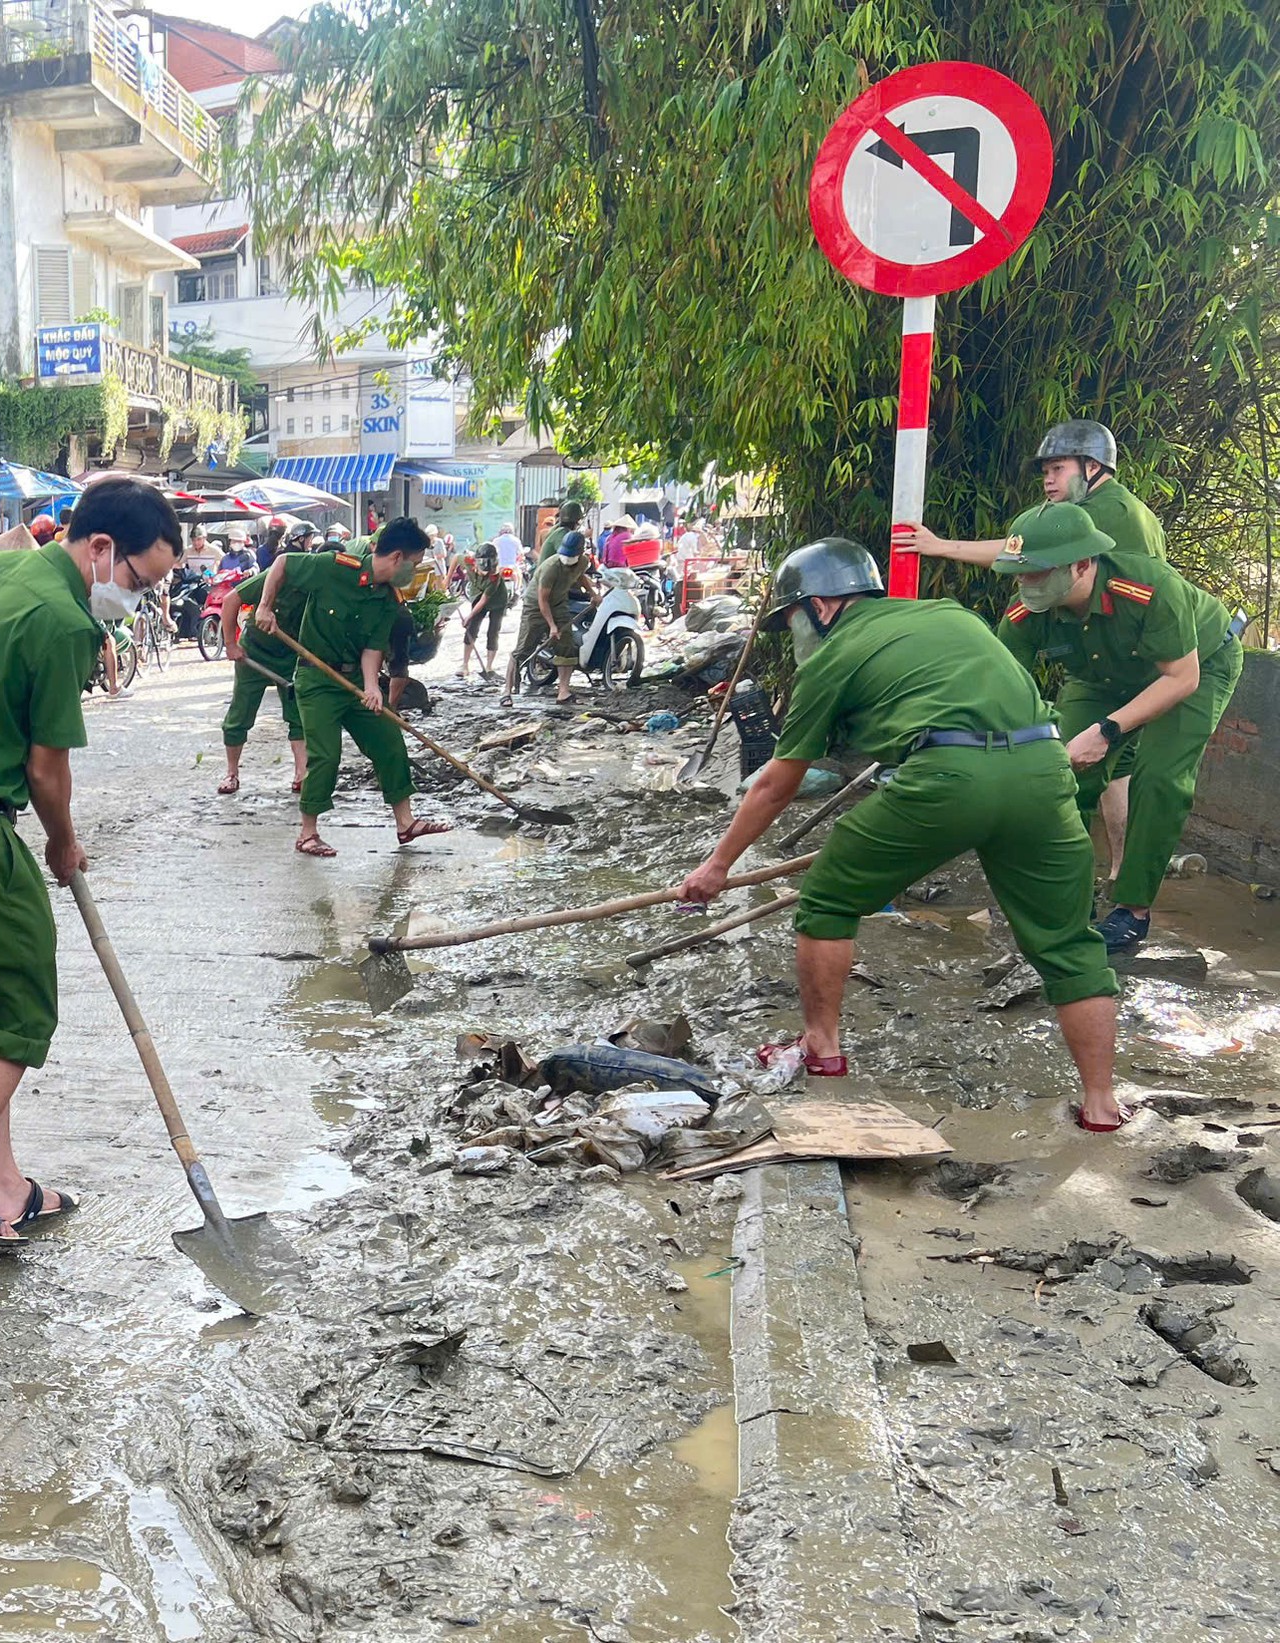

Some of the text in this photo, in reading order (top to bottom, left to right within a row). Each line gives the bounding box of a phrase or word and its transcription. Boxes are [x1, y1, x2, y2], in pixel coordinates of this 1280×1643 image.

[371, 393, 390, 410] 3S
[363, 416, 400, 433] SKIN
[463, 467, 485, 476] SKIN
